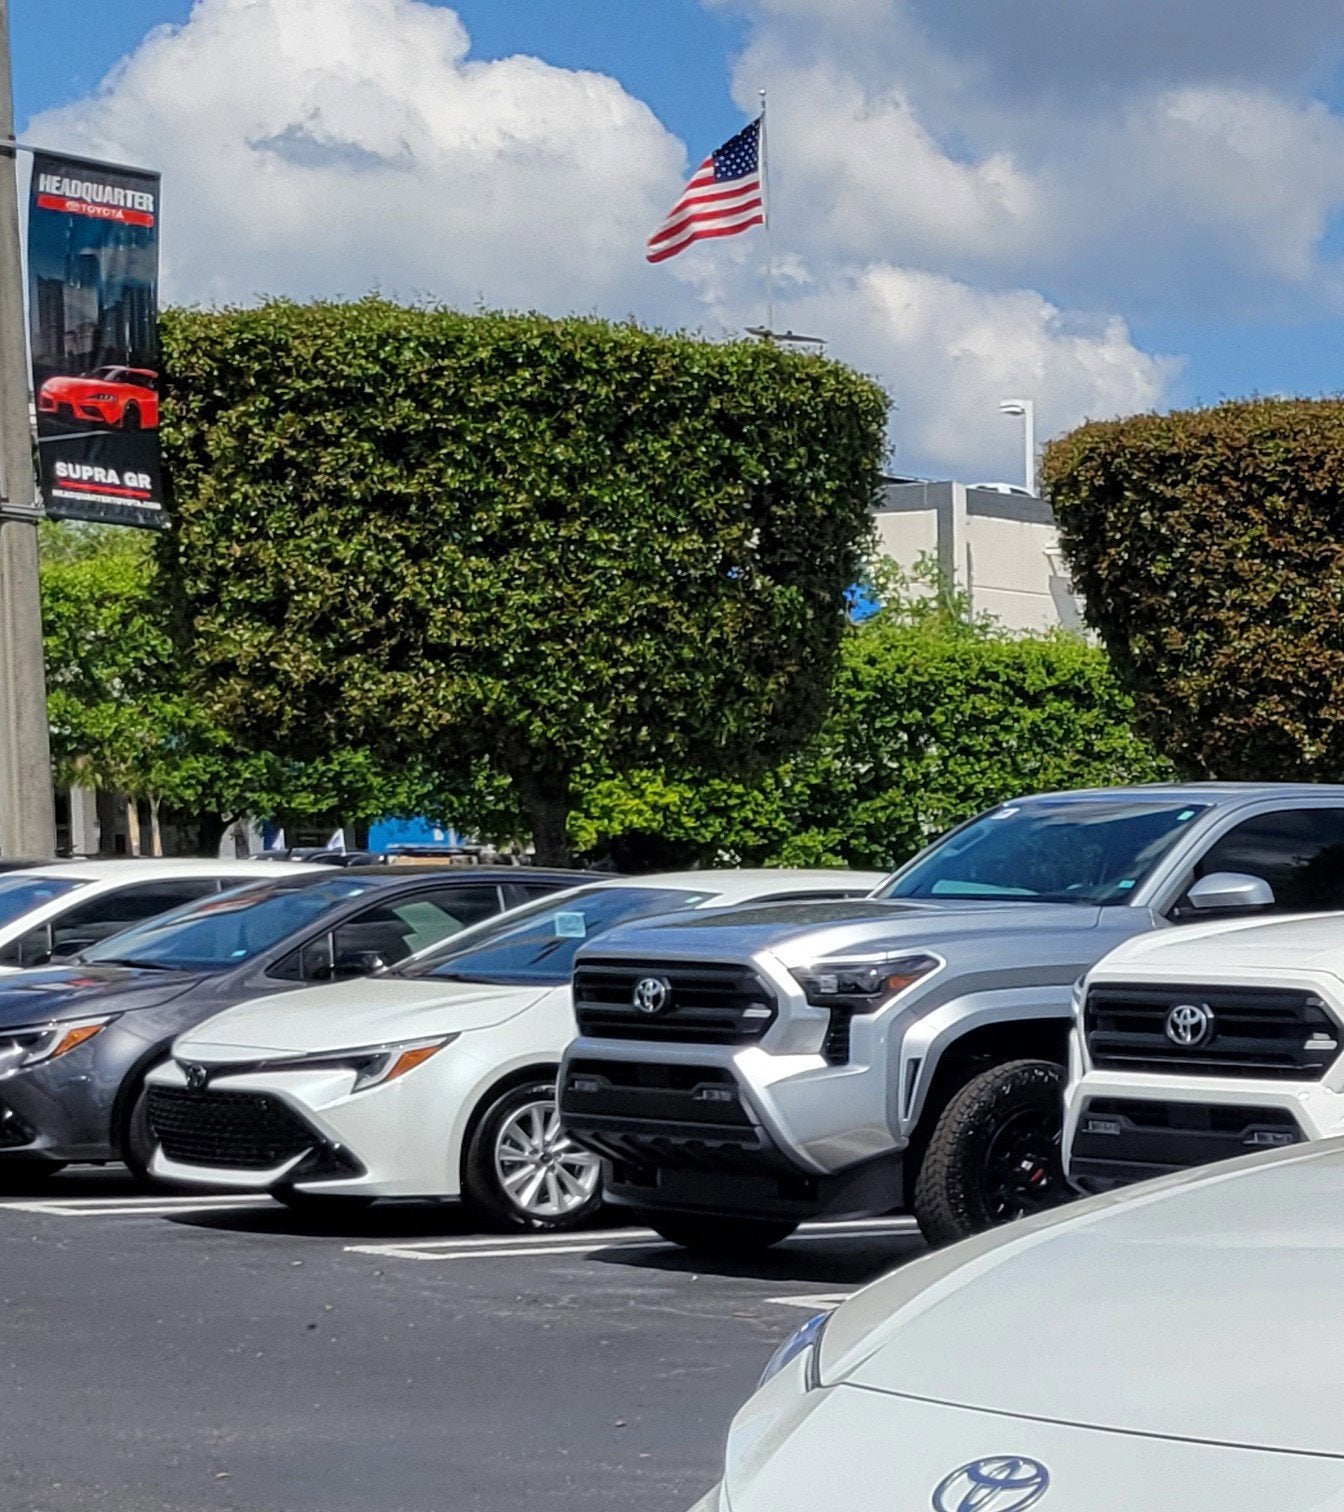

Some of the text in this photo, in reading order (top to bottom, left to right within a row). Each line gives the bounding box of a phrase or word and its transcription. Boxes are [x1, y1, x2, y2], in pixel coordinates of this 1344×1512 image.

[39, 172, 155, 213] HEADQUARTER
[81, 204, 125, 220] TOYOTA
[55, 461, 152, 490] SUPRA GR
